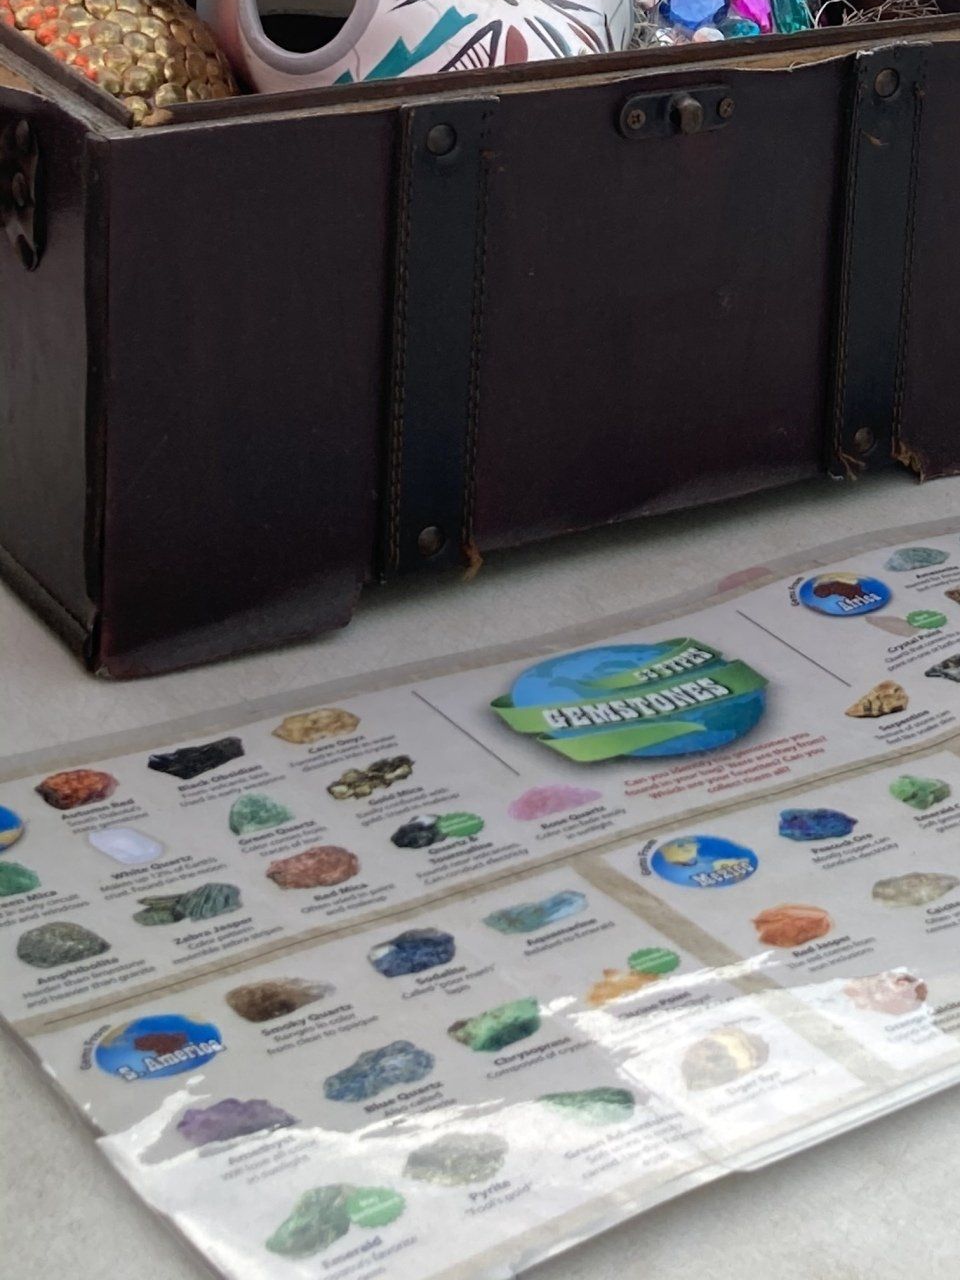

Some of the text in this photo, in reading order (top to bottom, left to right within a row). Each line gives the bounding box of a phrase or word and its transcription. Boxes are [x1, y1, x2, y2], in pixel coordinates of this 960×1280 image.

[836, 591, 882, 612] Africa
[887, 628, 943, 654] Crystal Point
[541, 676, 732, 730] GEMSTONES
[879, 708, 930, 732] Serpentine
[177, 764, 263, 793] Black Obsidian
[624, 772, 649, 788] Can
[651, 769, 670, 783] you
[671, 756, 712, 777] identify
[650, 783, 677, 799] Which
[783, 752, 802, 765] Can
[804, 748, 825, 762] you
[61, 797, 135, 821] Autumn Red
[368, 785, 424, 807] Gold Mica
[540, 805, 607, 831] Rose Quartz
[238, 820, 317, 847] Green Quartz
[428, 840, 463, 856] Quartz
[111, 854, 193, 882] White Quartz
[689, 857, 754, 888] Mexico
[27, 890, 58, 902] Mica
[313, 881, 369, 903] Red Mica
[173, 916, 252, 946] Zebra Jasper
[792, 935, 851, 958] Red Jasper
[37, 955, 119, 985] Amphibolite
[63, 973, 90, 988] than
[27, 995, 48, 1009] and
[261, 1003, 353, 1038] Smoky Quartz
[143, 1037, 222, 1073] America
[364, 1081, 443, 1114] Blue Quartz
[469, 1179, 511, 1202] Pyrite
